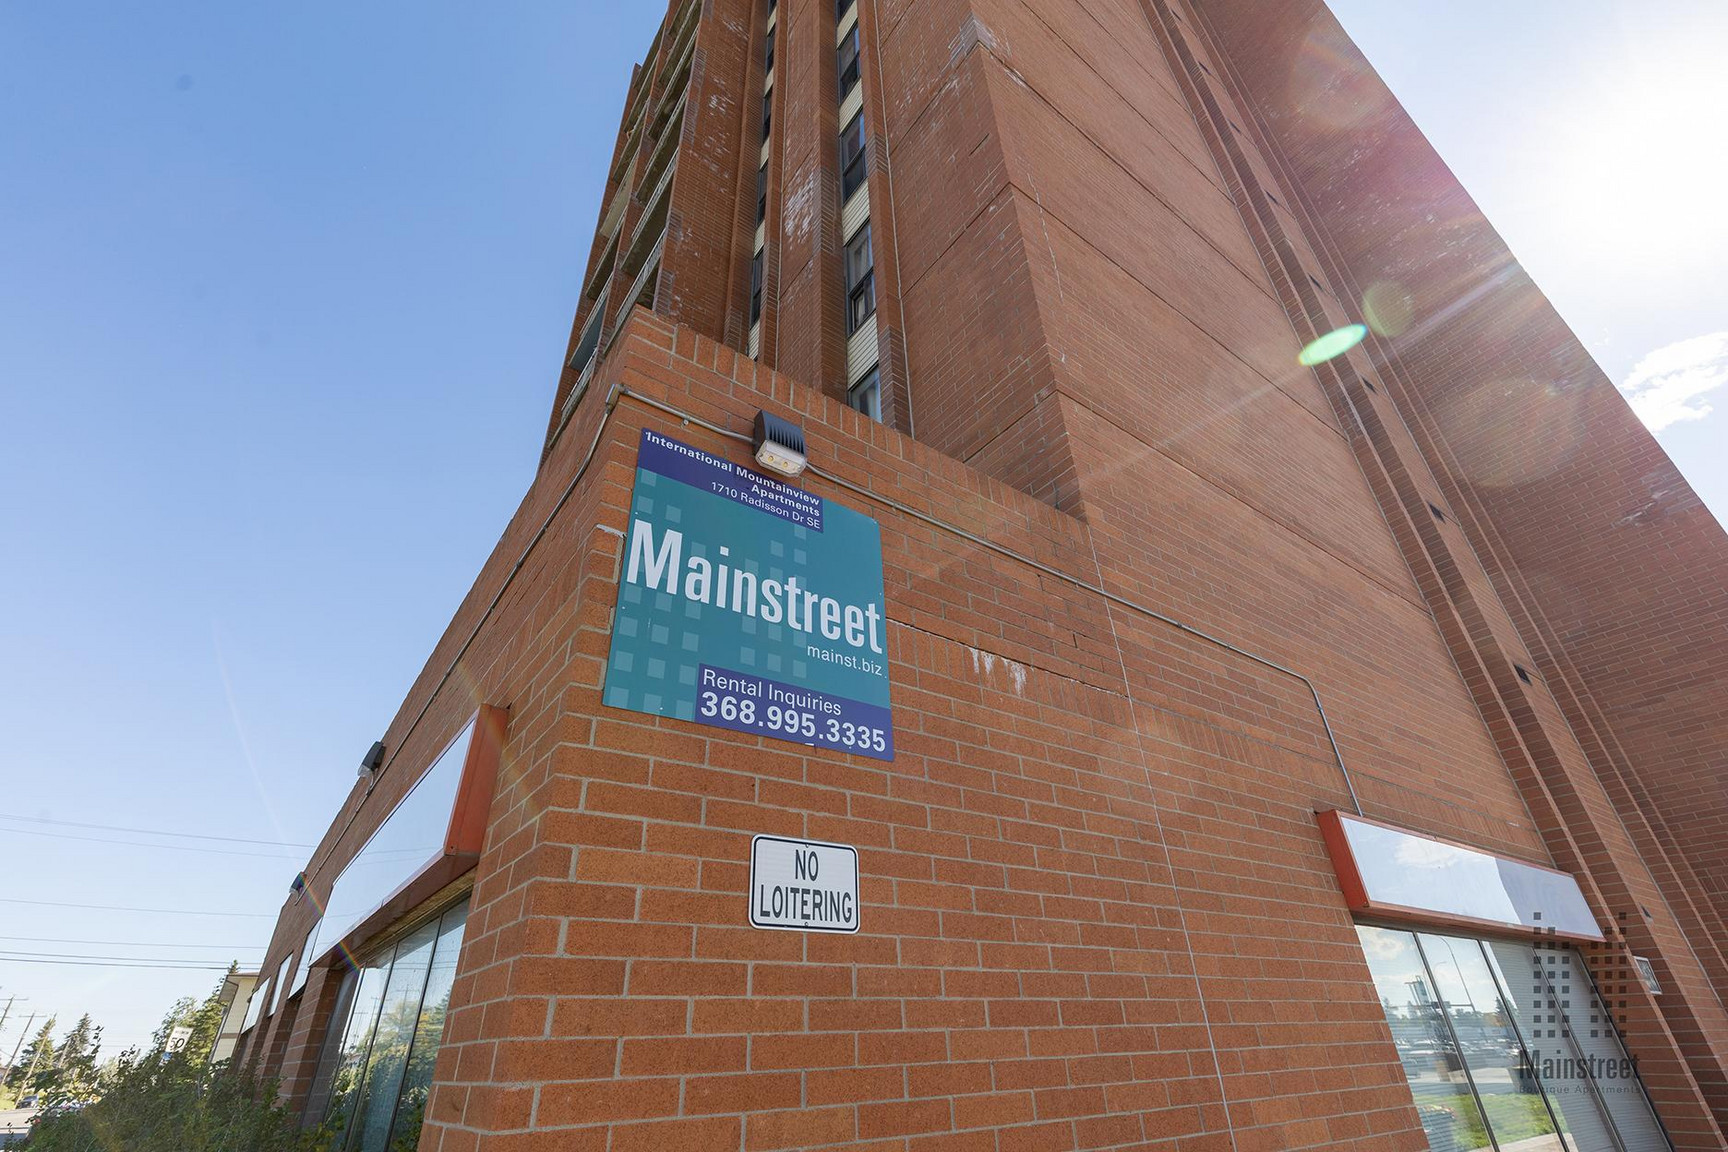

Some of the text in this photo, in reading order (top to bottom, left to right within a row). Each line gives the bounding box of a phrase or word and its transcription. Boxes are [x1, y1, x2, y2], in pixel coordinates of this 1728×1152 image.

[645, 431, 820, 506] International Mountainview
[711, 482, 821, 530] 1710 Radisson Dr SE
[751, 484, 820, 517] Apartments
[626, 518, 883, 654] Mainstreet
[807, 645, 883, 677] mainst.biz
[703, 668, 842, 716] Rental Inquiries
[700, 691, 886, 752] 368.995.3335
[795, 849, 819, 881] NO
[760, 884, 852, 923] LOITERING
